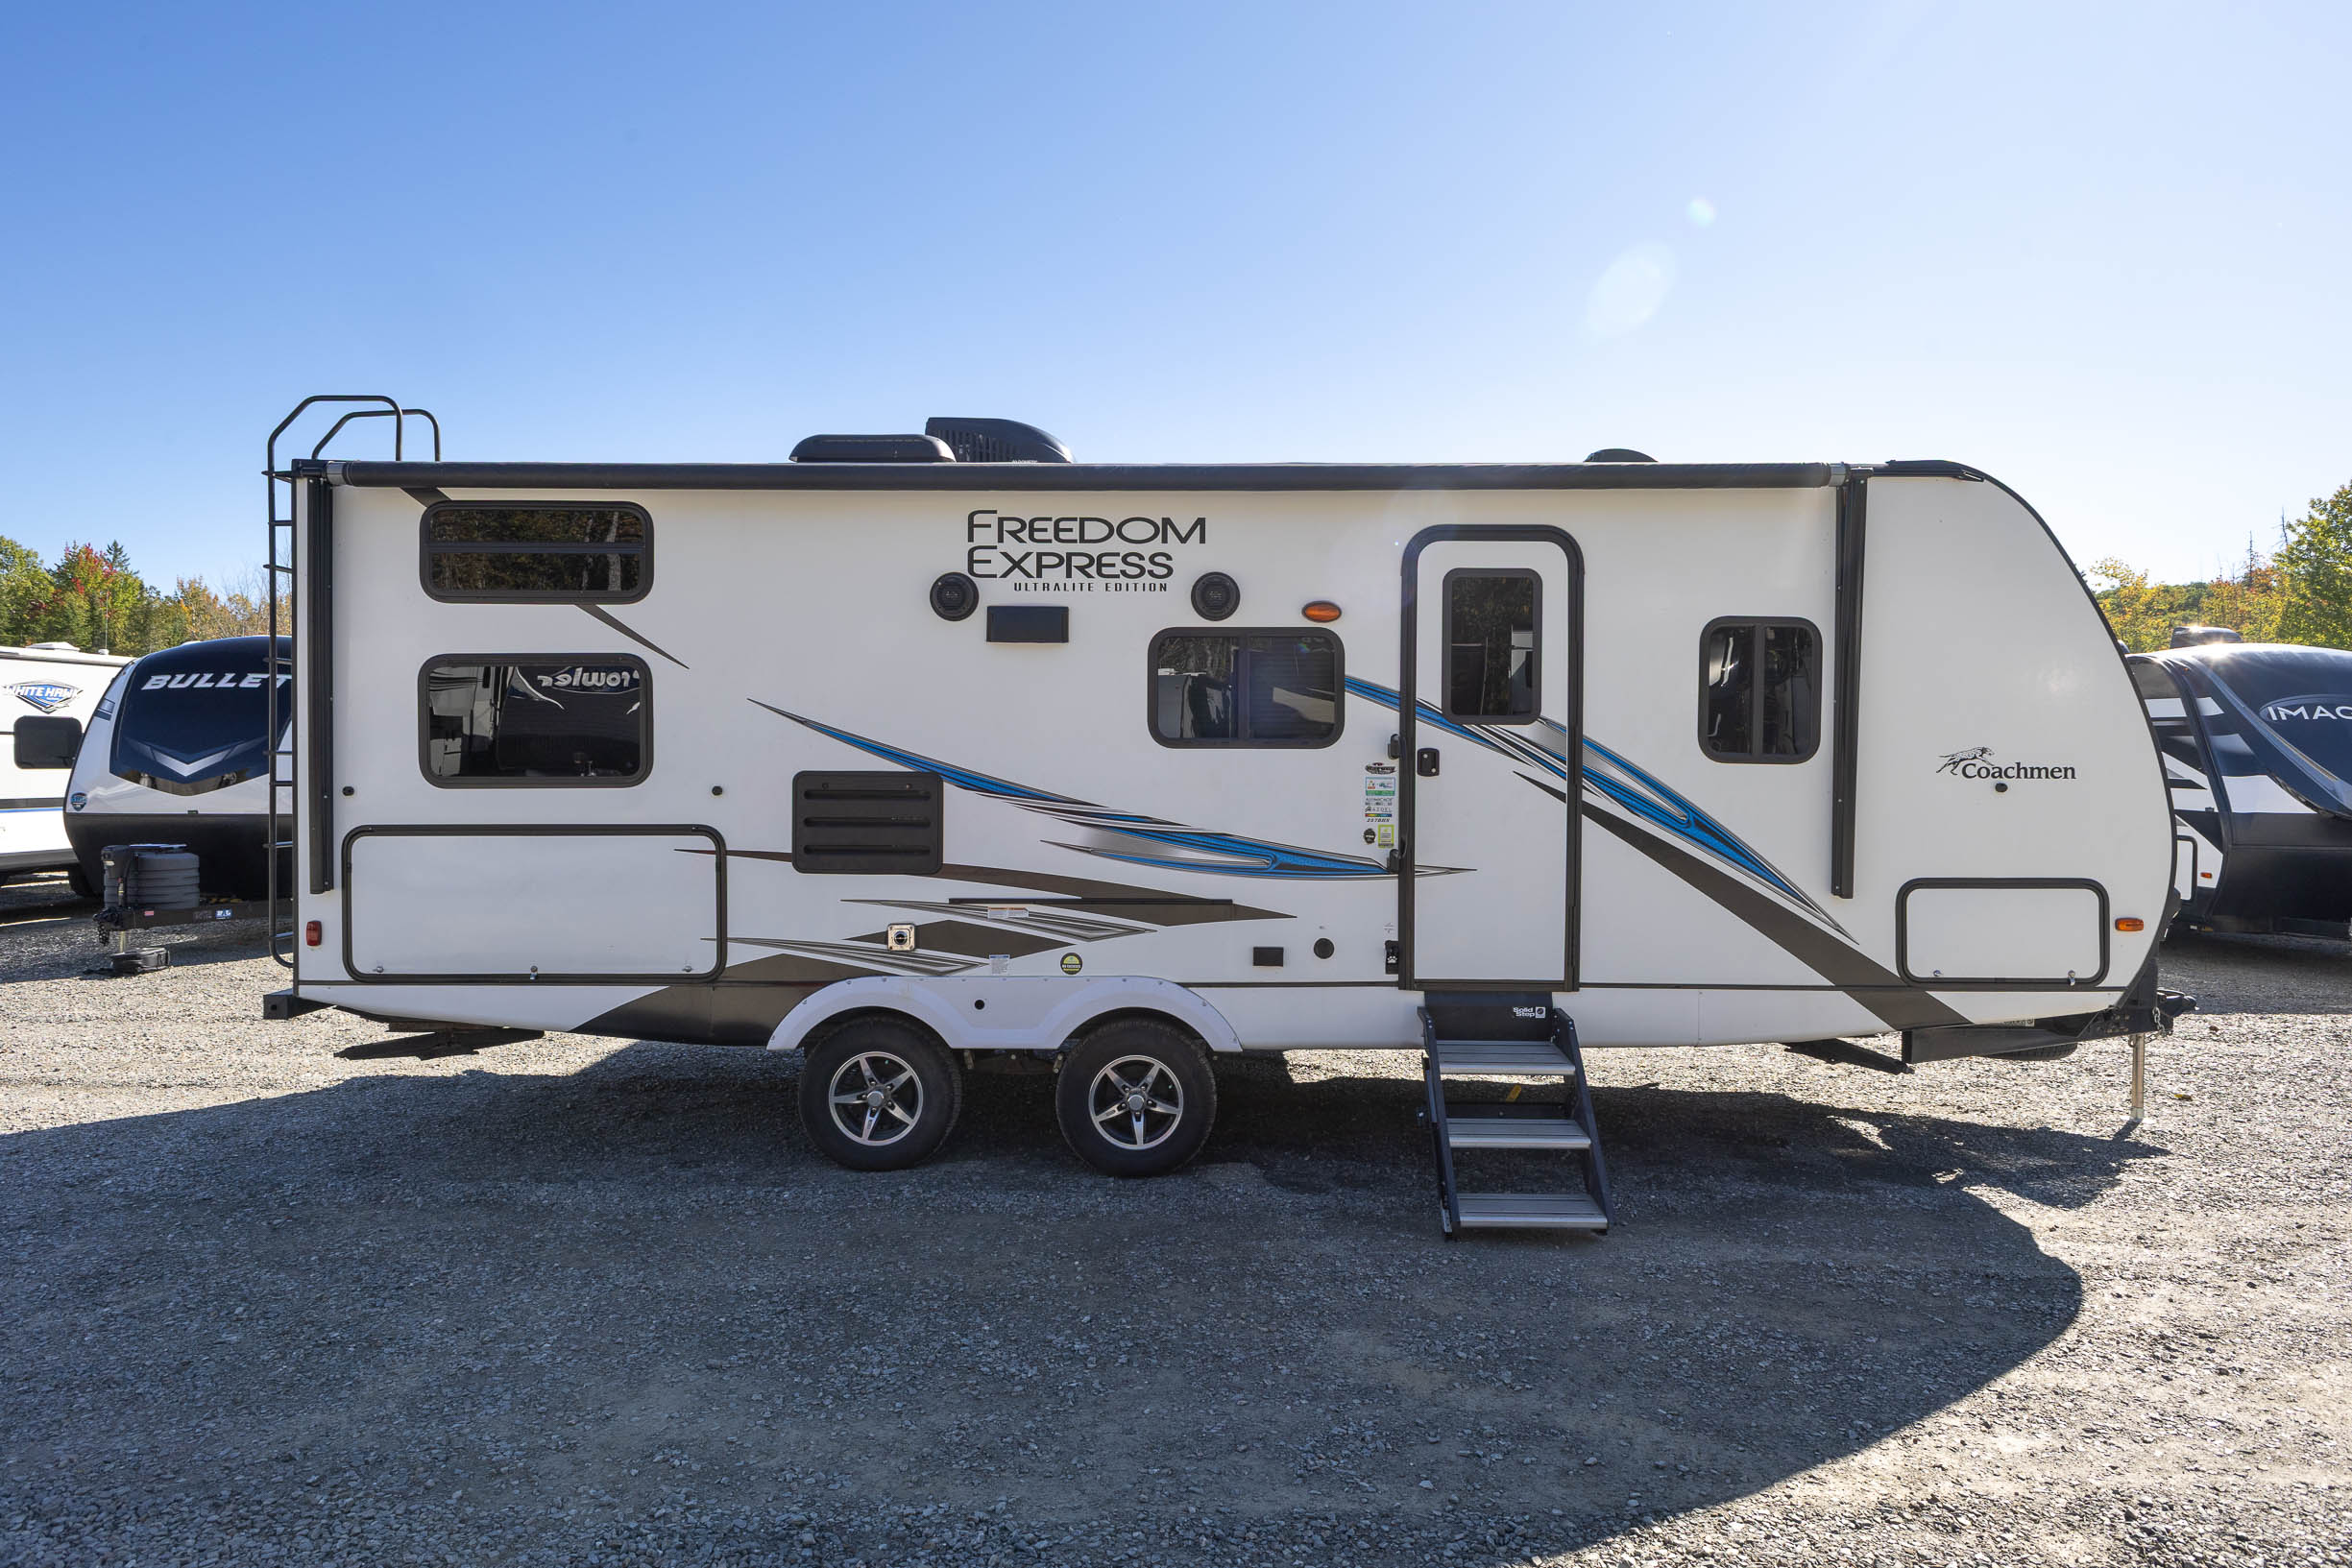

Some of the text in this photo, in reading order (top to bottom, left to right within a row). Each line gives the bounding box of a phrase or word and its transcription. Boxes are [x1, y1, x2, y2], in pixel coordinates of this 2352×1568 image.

[967, 509, 1206, 544] FREEDOM
[967, 544, 1174, 580] EXPRESS
[1013, 582, 1168, 592] ULTRALITE EDITION
[6, 685, 45, 697] WHITE
[1961, 761, 2076, 780] Coachmen
